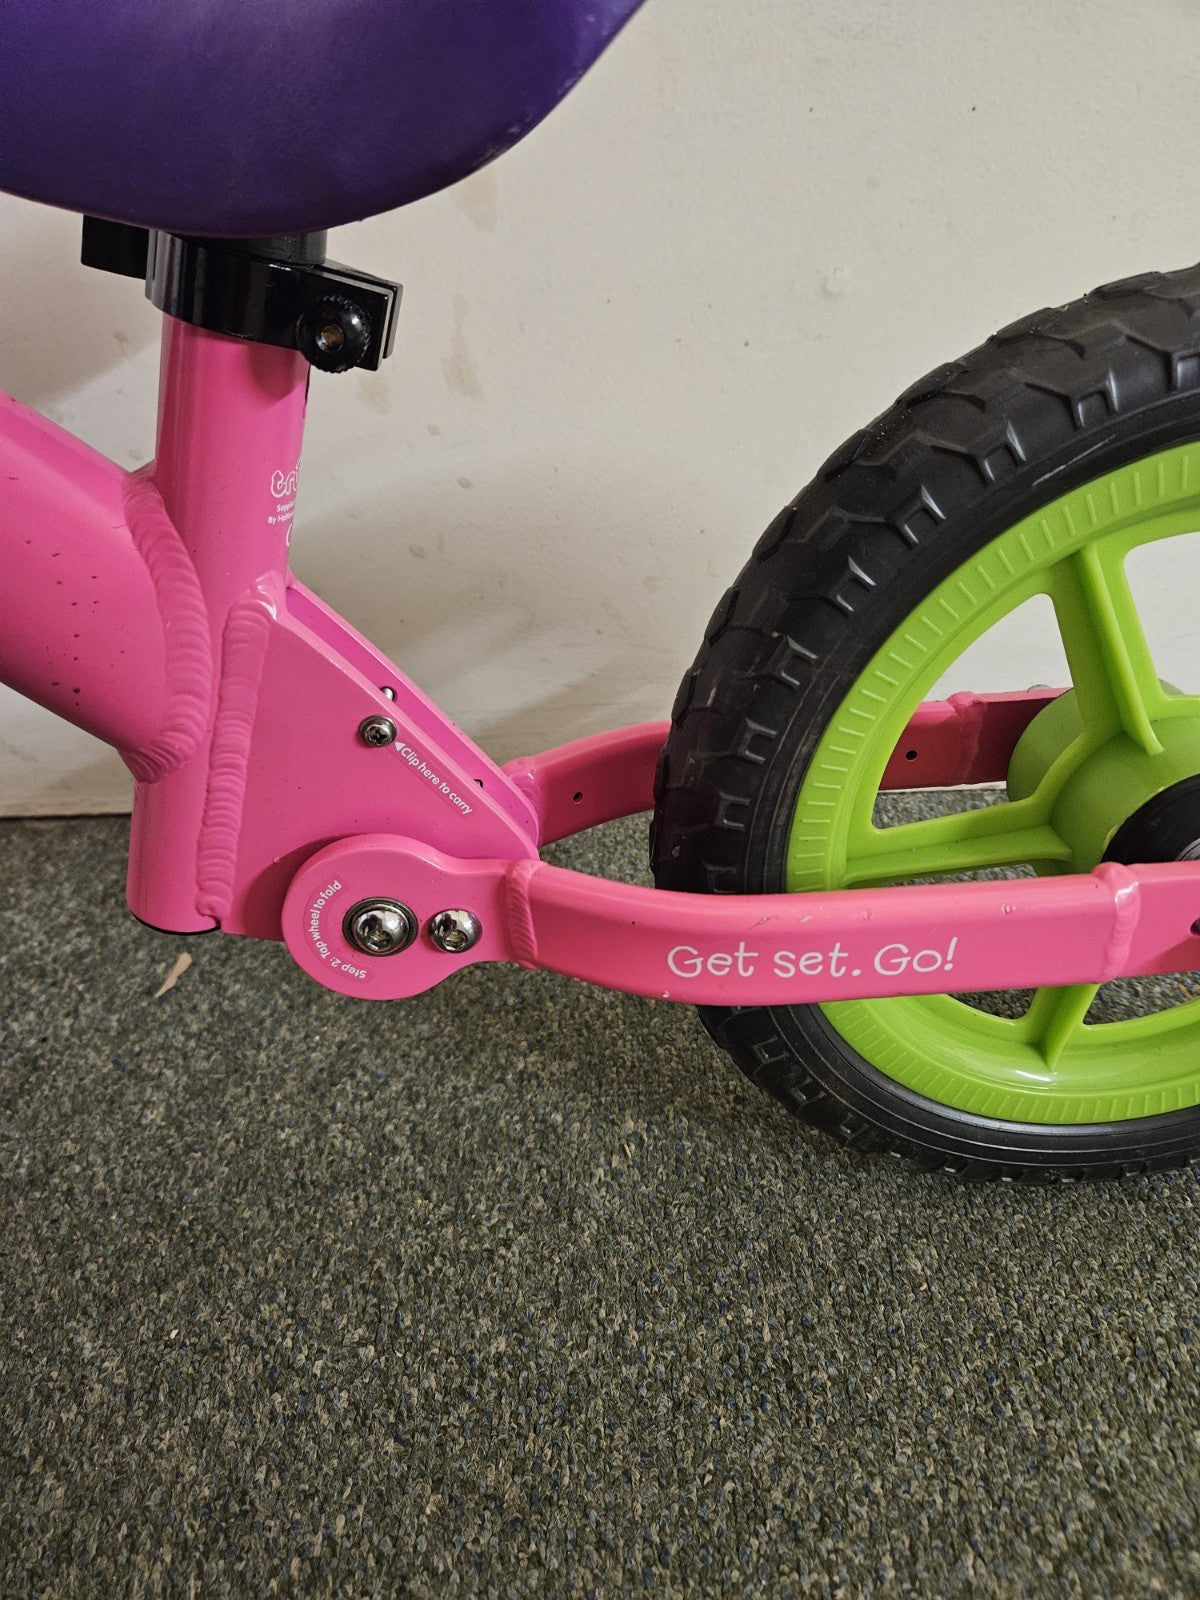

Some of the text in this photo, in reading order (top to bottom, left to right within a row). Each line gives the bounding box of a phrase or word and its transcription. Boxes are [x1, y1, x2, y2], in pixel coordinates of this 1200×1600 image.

[268, 516, 277, 525] By
[401, 747, 473, 815] Clip here to carry
[319, 880, 342, 899] fold
[313, 898, 326, 909] to
[308, 909, 321, 941] wheel
[315, 941, 331, 959] Tap
[667, 936, 958, 978] Get set. Go!
[341, 963, 367, 979] Step
